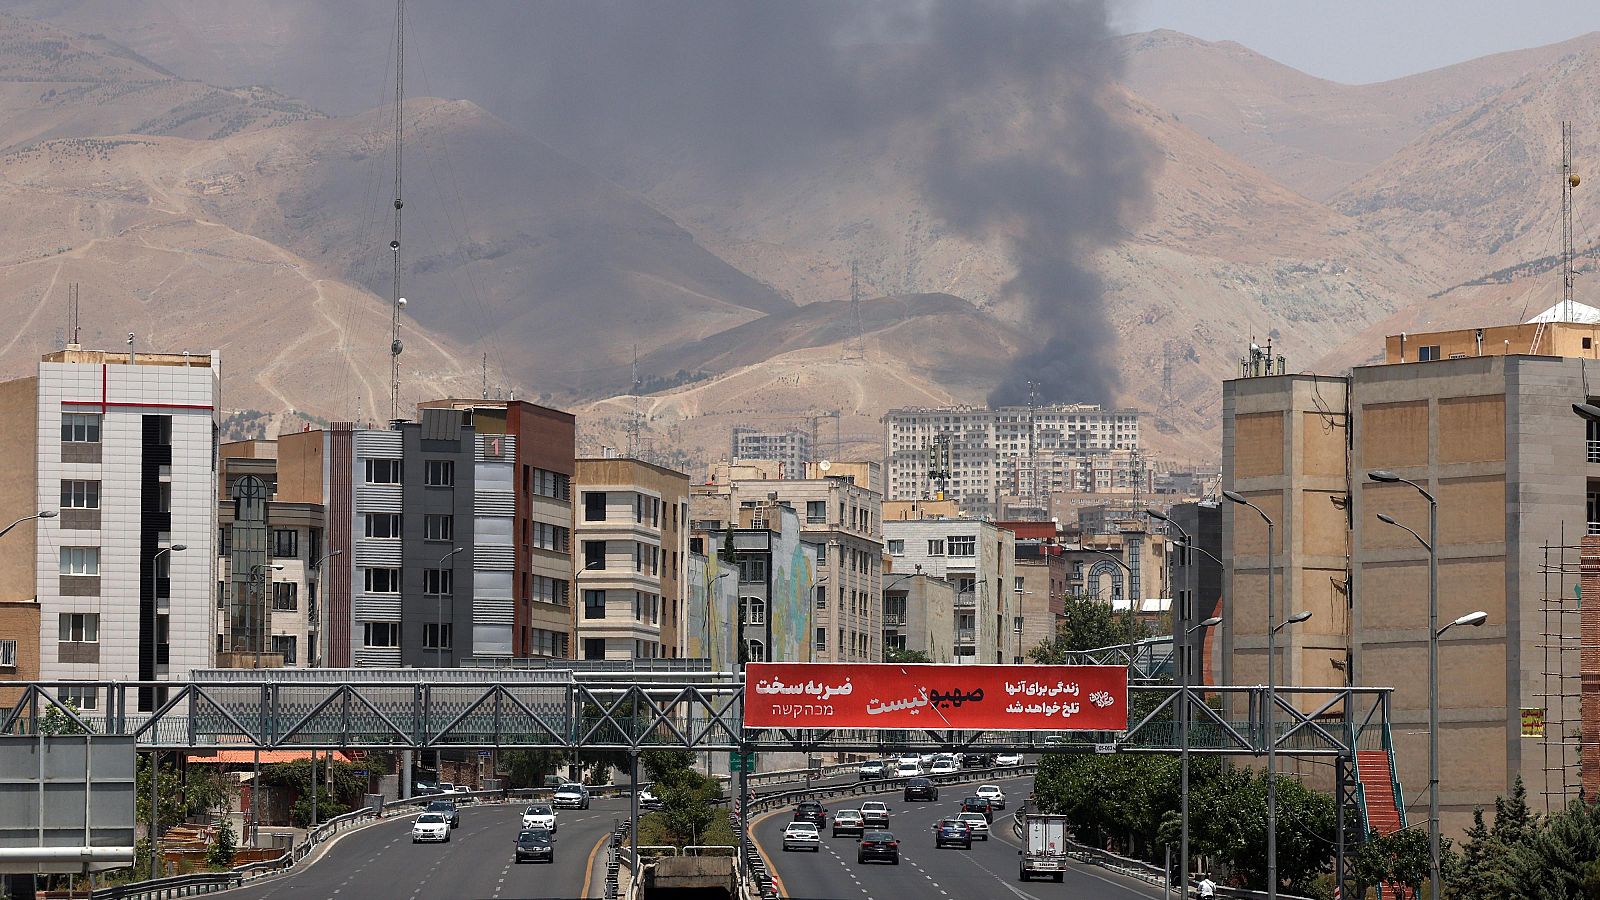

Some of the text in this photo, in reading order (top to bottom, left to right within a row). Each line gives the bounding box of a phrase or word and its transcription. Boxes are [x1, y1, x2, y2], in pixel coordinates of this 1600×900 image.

[491, 438, 499, 457] 1
[755, 676, 853, 700] ضربه سخت
[1005, 680, 1080, 697] زندگی برای آنها
[1005, 700, 1080, 718] تلخ خواهد شد
